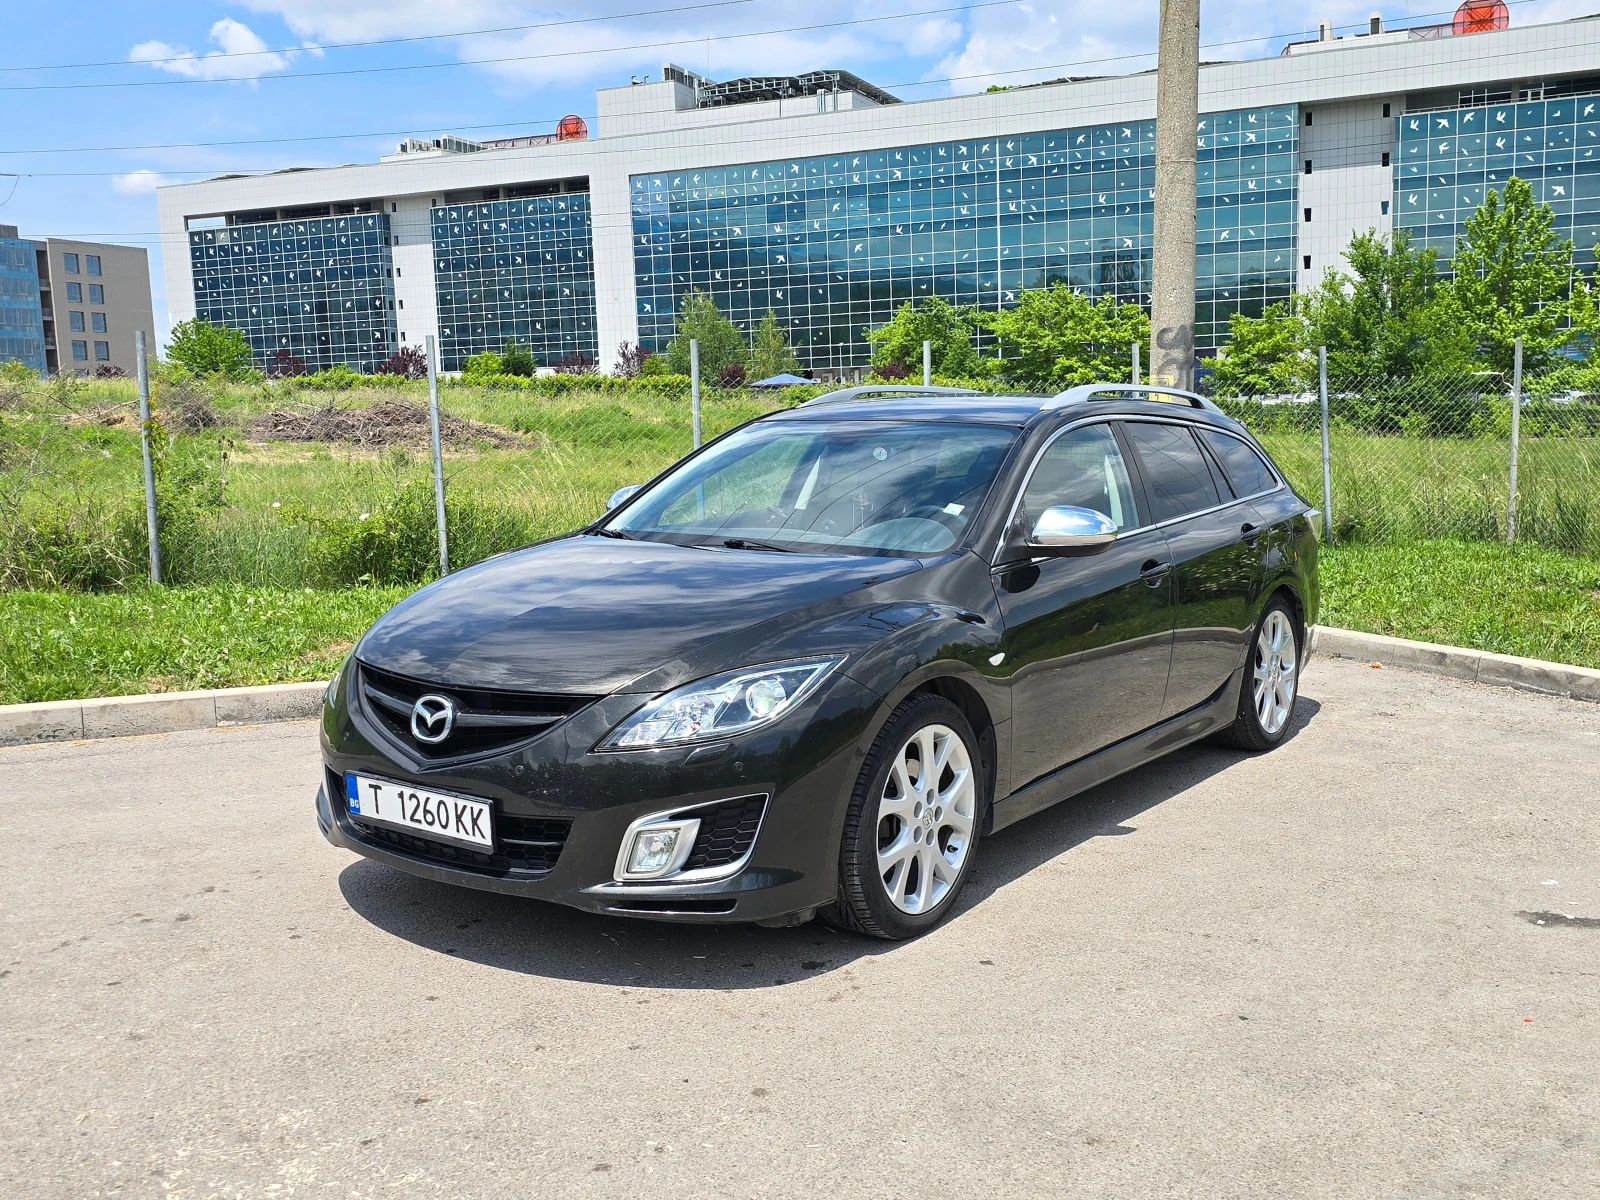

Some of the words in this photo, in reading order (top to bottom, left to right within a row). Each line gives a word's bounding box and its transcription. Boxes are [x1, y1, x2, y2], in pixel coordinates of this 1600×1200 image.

[350, 798, 359, 808] BG
[368, 784, 382, 814] T
[398, 791, 449, 829] 1260
[455, 802, 486, 839] KK
